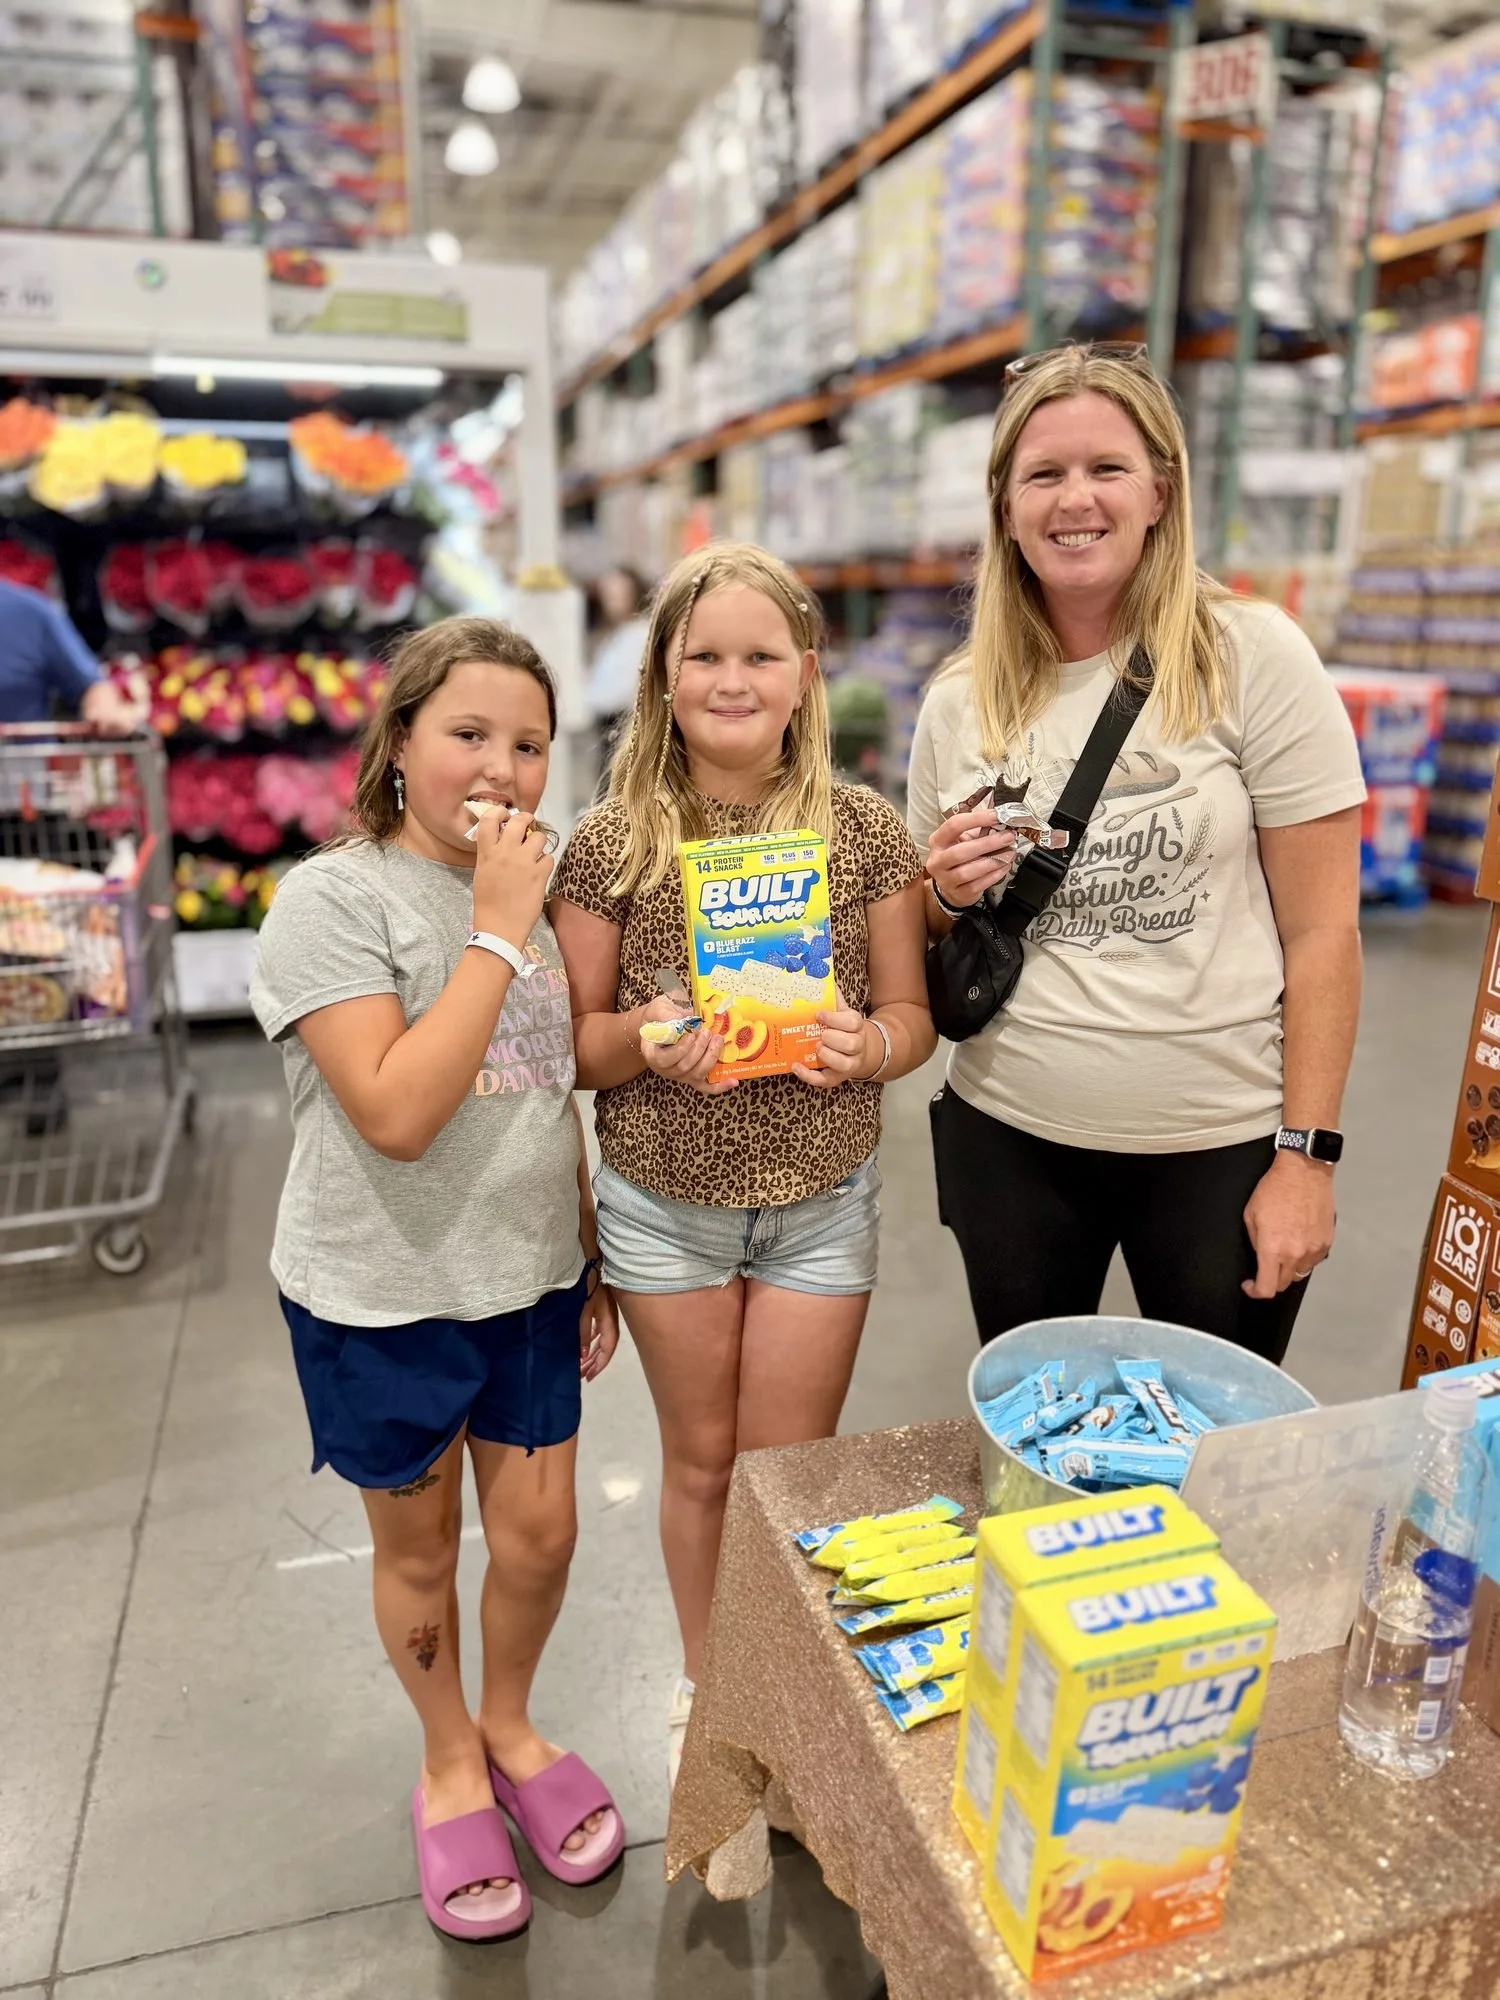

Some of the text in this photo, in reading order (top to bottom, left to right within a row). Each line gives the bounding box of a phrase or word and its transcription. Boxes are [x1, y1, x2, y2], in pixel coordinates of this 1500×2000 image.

[696, 856, 744, 874] 14 PROTEIN
[714, 863, 743, 873] SNACKS
[1069, 871, 1082, 887] &
[699, 869, 817, 911] BUILT
[1043, 873, 1168, 920] ripture:
[710, 900, 806, 928] SOUR PUFF
[1037, 894, 1197, 946] Daily Bread
[716, 937, 756, 948] BLUE RAZZ
[716, 945, 740, 954] BLAST
[506, 968, 569, 1003] NCES
[498, 998, 567, 1036] ANCE
[782, 1023, 828, 1035] SWEET PEA
[806, 1029, 825, 1038] PUN
[486, 1027, 567, 1065] MORE
[1445, 1207, 1480, 1262] IQ
[1441, 1241, 1477, 1281] BAR
[1146, 1381, 1187, 1432] UILT
[1026, 1503, 1162, 1555] BUILT
[1068, 1574, 1214, 1633] BUILT
[1077, 1665, 1258, 1747] BUILT
